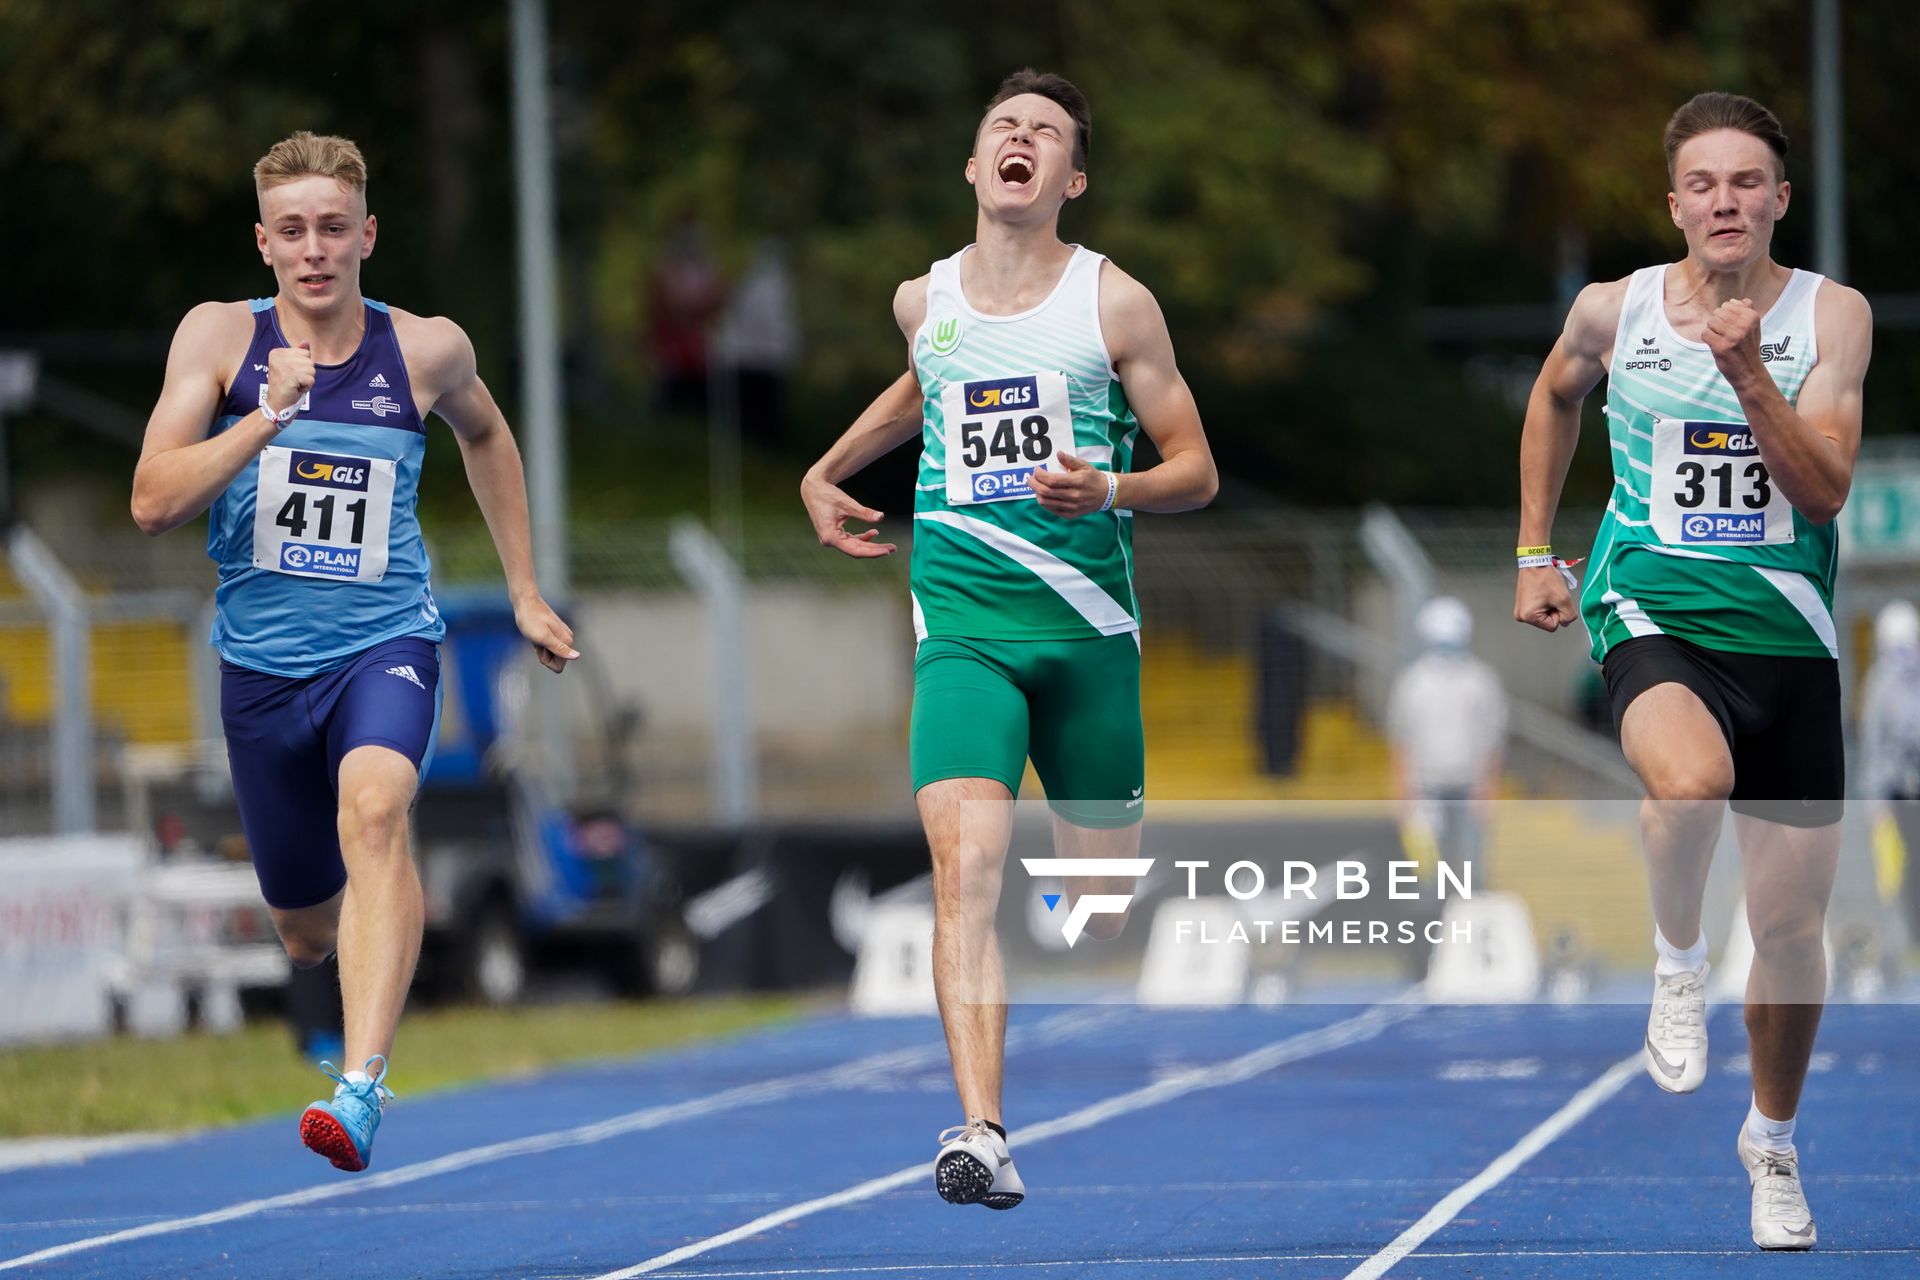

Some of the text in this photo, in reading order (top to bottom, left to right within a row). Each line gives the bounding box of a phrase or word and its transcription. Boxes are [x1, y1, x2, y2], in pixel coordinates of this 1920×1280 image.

[1636, 347, 1660, 355] erima
[1625, 359, 1672, 371] SPORT 39
[1001, 386, 1031, 405] GLS
[961, 415, 1052, 468] 548
[332, 466, 364, 485] GLS
[1002, 472, 1031, 487] PLA
[1674, 461, 1771, 509] 313
[276, 491, 367, 544] 411
[1716, 518, 1762, 532] PLAN
[313, 550, 358, 567] PLAN
[313, 565, 355, 574] INTERNATIONAL
